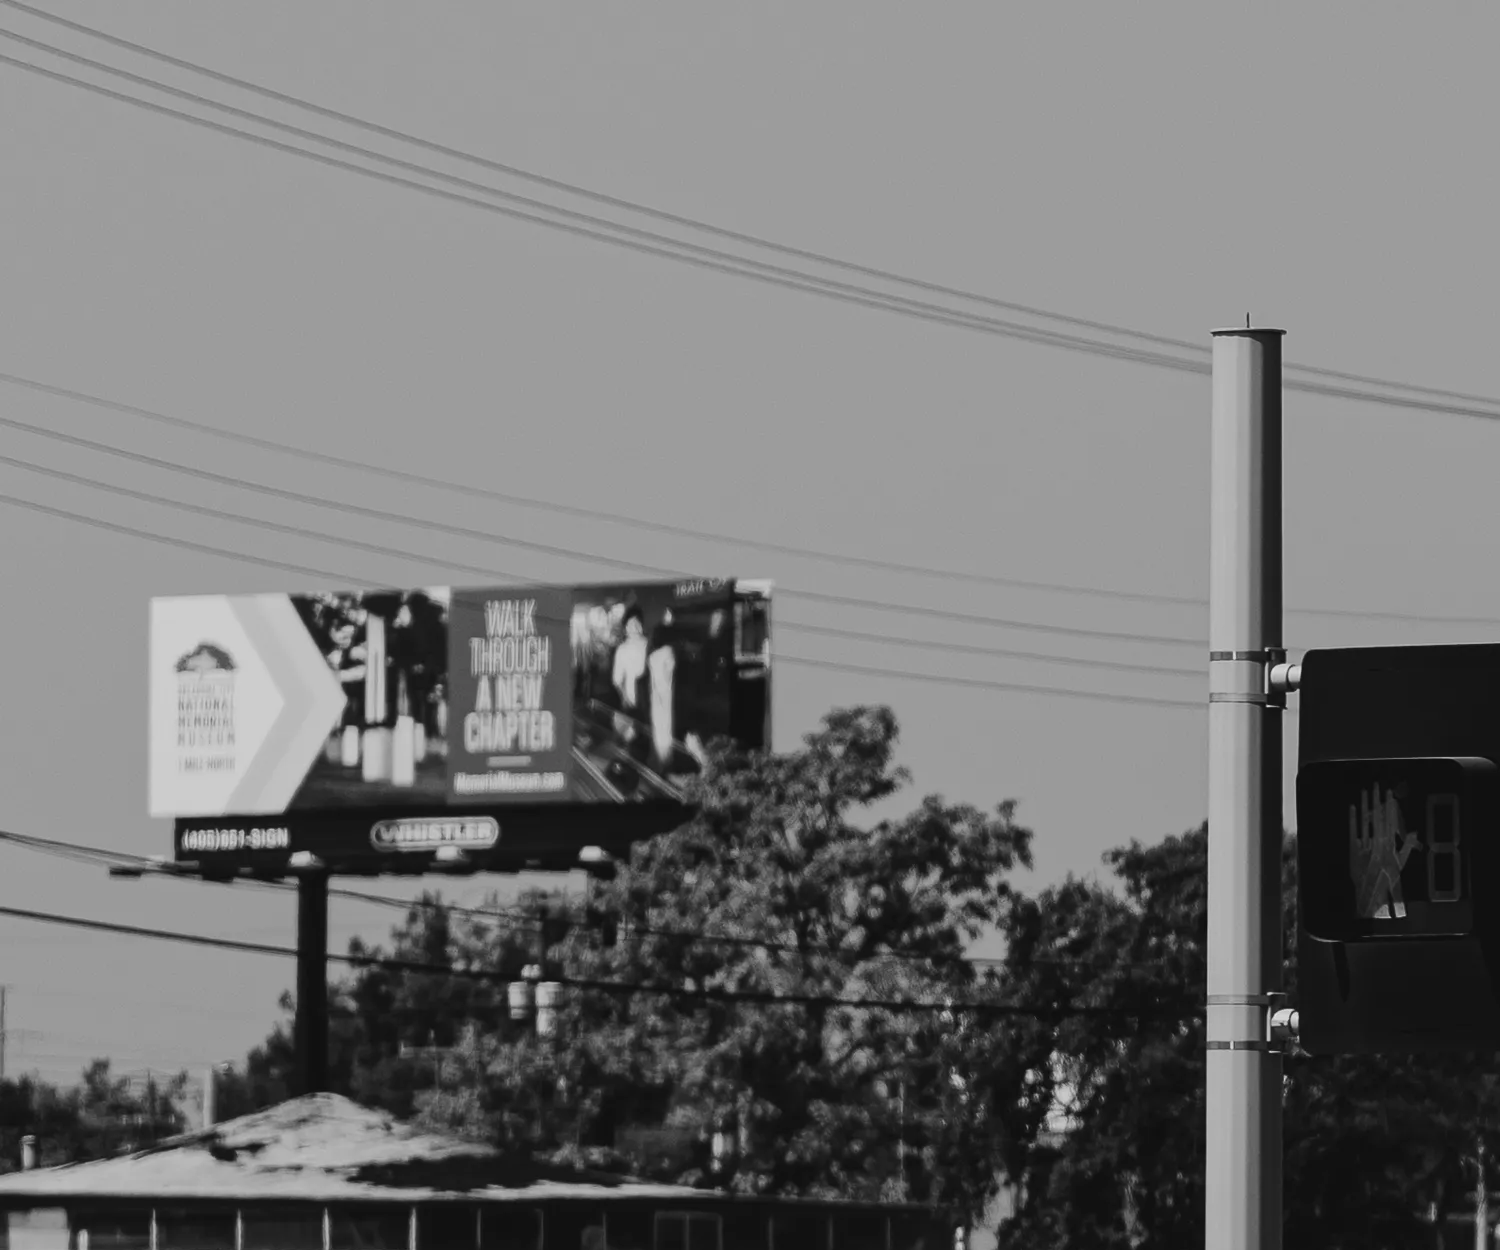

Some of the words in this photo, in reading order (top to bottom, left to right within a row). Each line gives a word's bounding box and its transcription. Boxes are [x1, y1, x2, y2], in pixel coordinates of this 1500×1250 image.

[484, 599, 537, 637] WALK
[469, 637, 551, 676] THROUGH
[475, 675, 492, 711] A
[495, 675, 543, 711] NEW
[177, 731, 236, 747] MUSEUM
[464, 711, 555, 753] CHAPTER
[378, 821, 493, 843] WHISTLER
